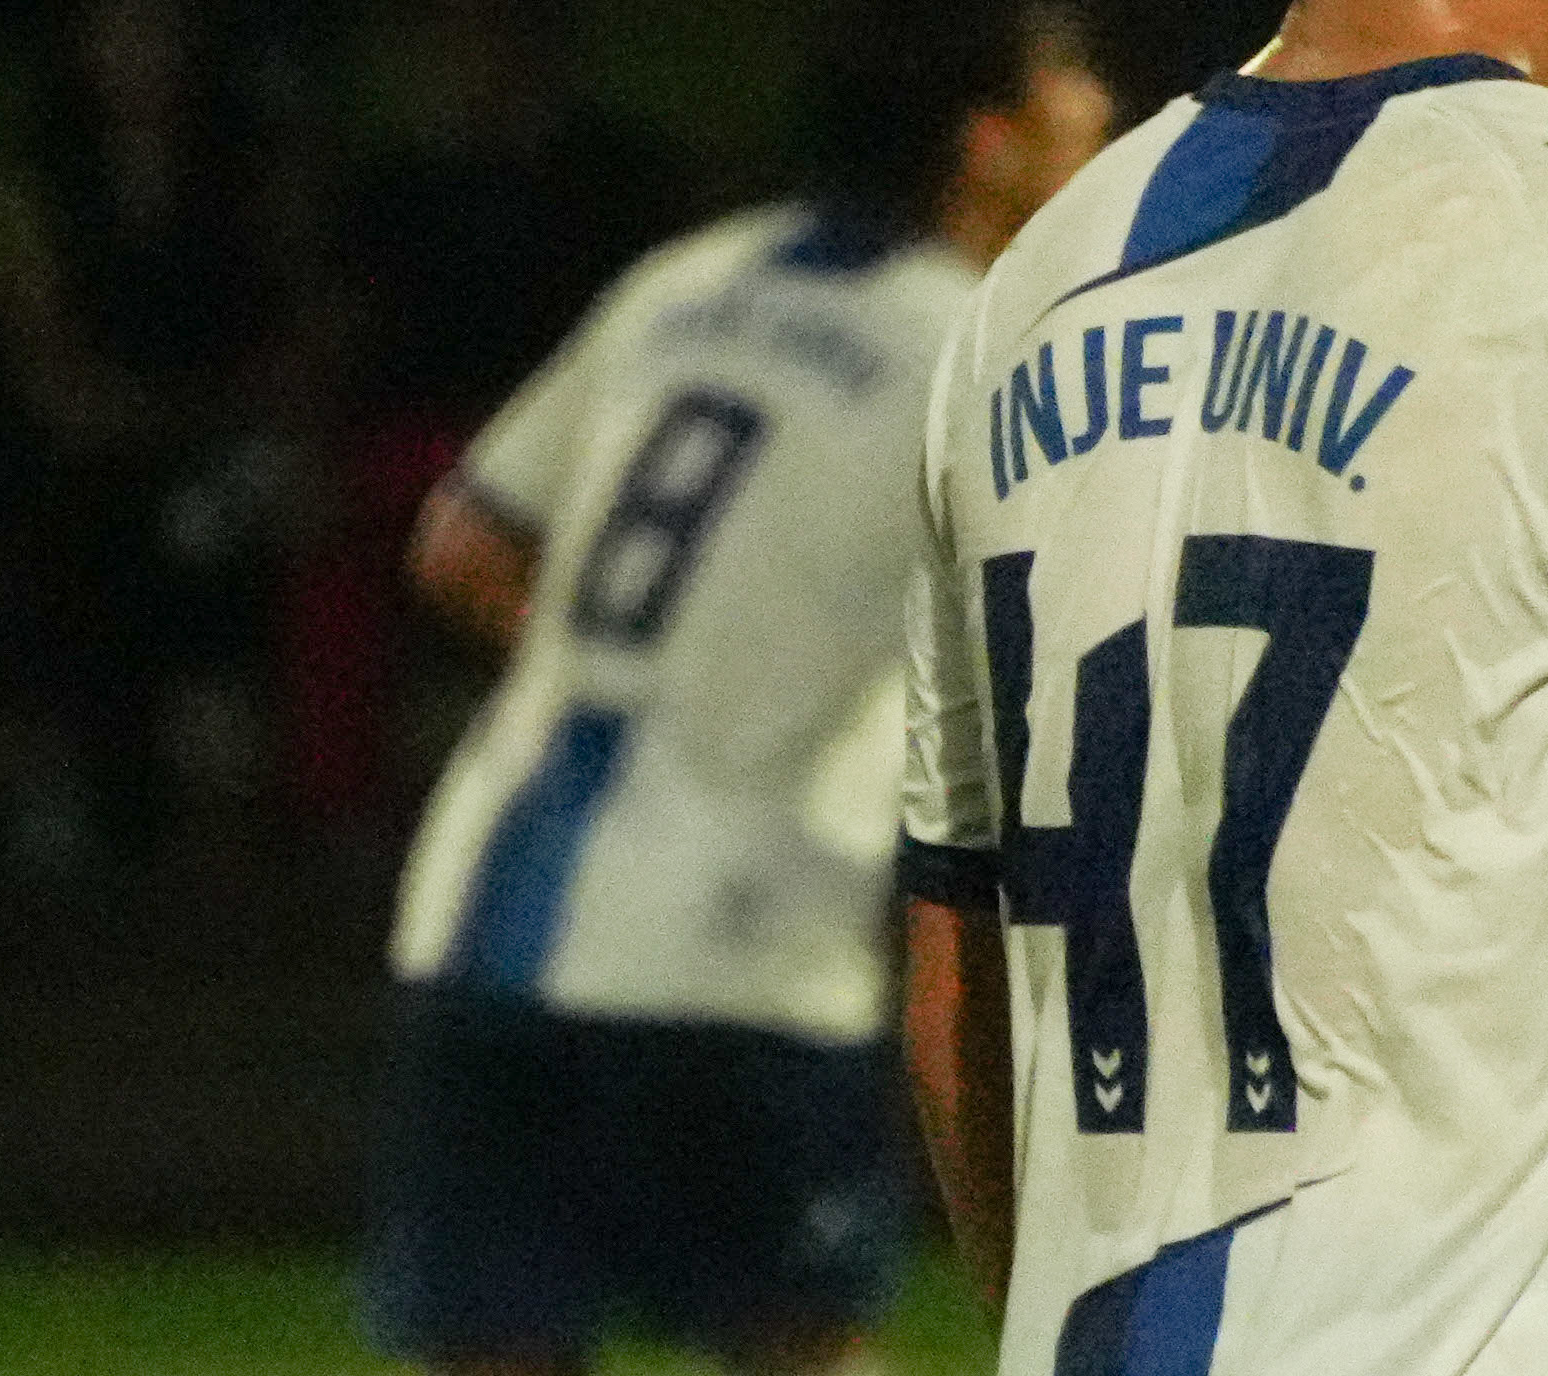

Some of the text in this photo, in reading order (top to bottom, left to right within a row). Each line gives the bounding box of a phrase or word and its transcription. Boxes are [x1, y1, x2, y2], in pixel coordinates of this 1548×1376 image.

[570, 388, 768, 644] 8
[990, 315, 1183, 502] INJE
[1200, 310, 1416, 492] UNIV.
[982, 533, 1376, 1134] 47
